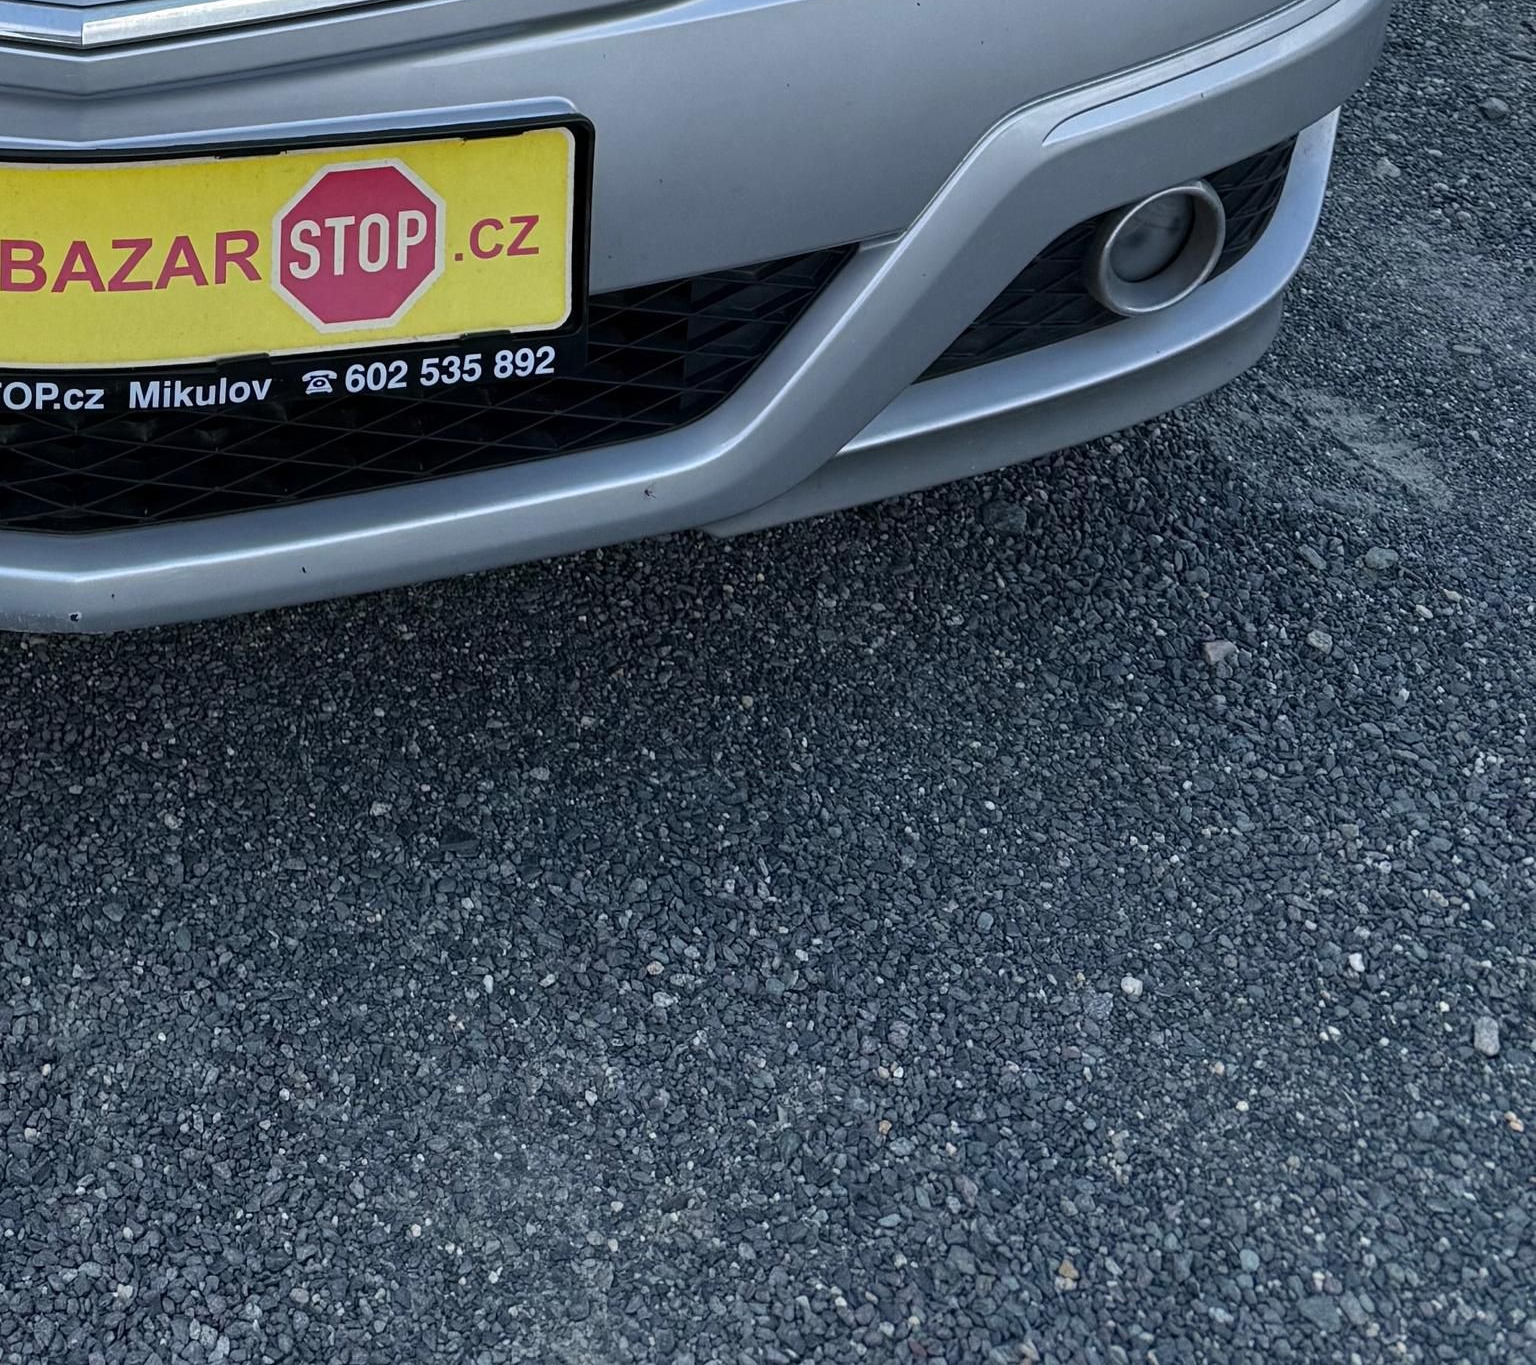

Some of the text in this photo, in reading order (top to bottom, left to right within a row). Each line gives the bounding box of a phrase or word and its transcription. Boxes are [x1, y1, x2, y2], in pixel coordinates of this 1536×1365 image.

[288, 209, 429, 281] STOP
[128, 374, 273, 410] Mikulov
[344, 361, 408, 394] 602
[420, 354, 483, 387] 535
[493, 345, 556, 379] 892
